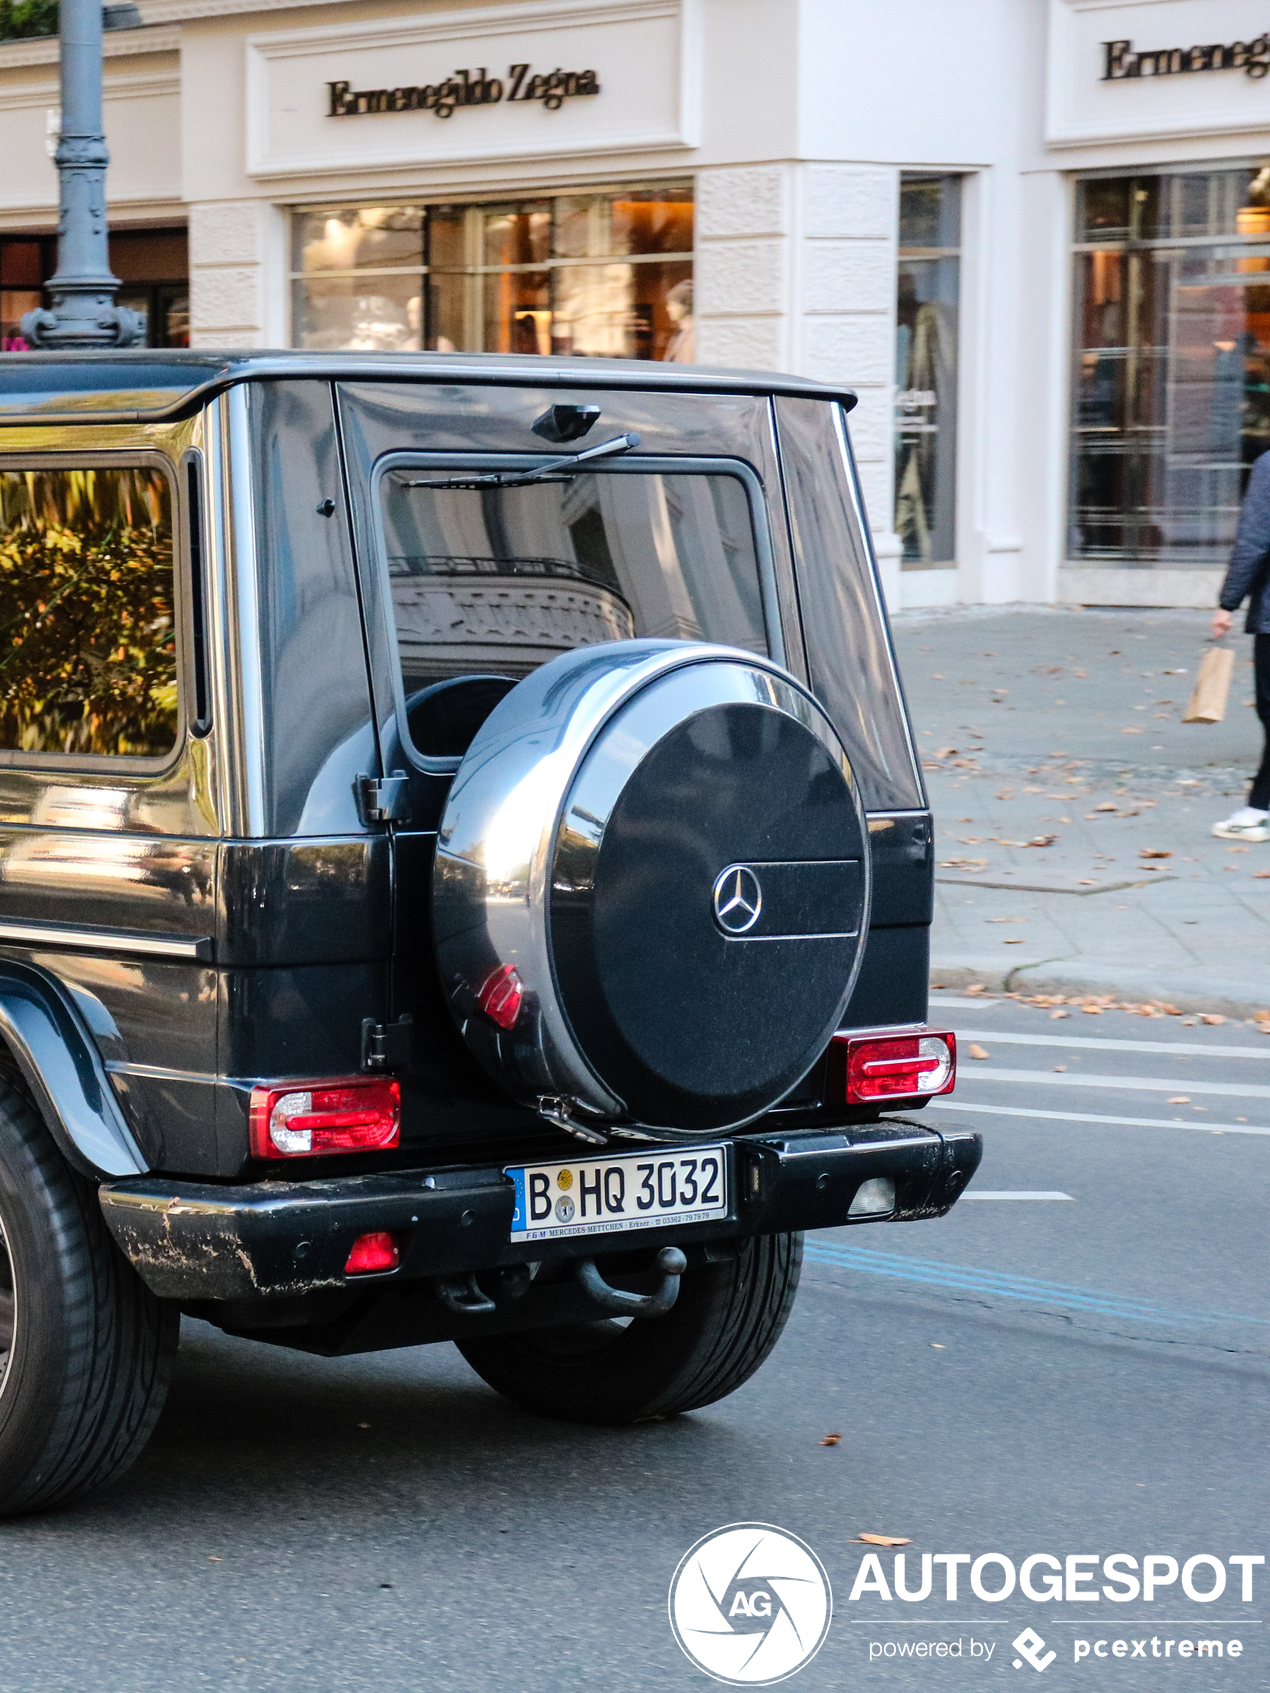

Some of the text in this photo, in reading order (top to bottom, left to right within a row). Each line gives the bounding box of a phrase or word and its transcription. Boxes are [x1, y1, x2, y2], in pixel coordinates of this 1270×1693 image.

[326, 63, 600, 118] Ermenegildo Zegna
[529, 1157, 719, 1220] B HQ 3032
[629, 1220, 649, 1229] Erkner
